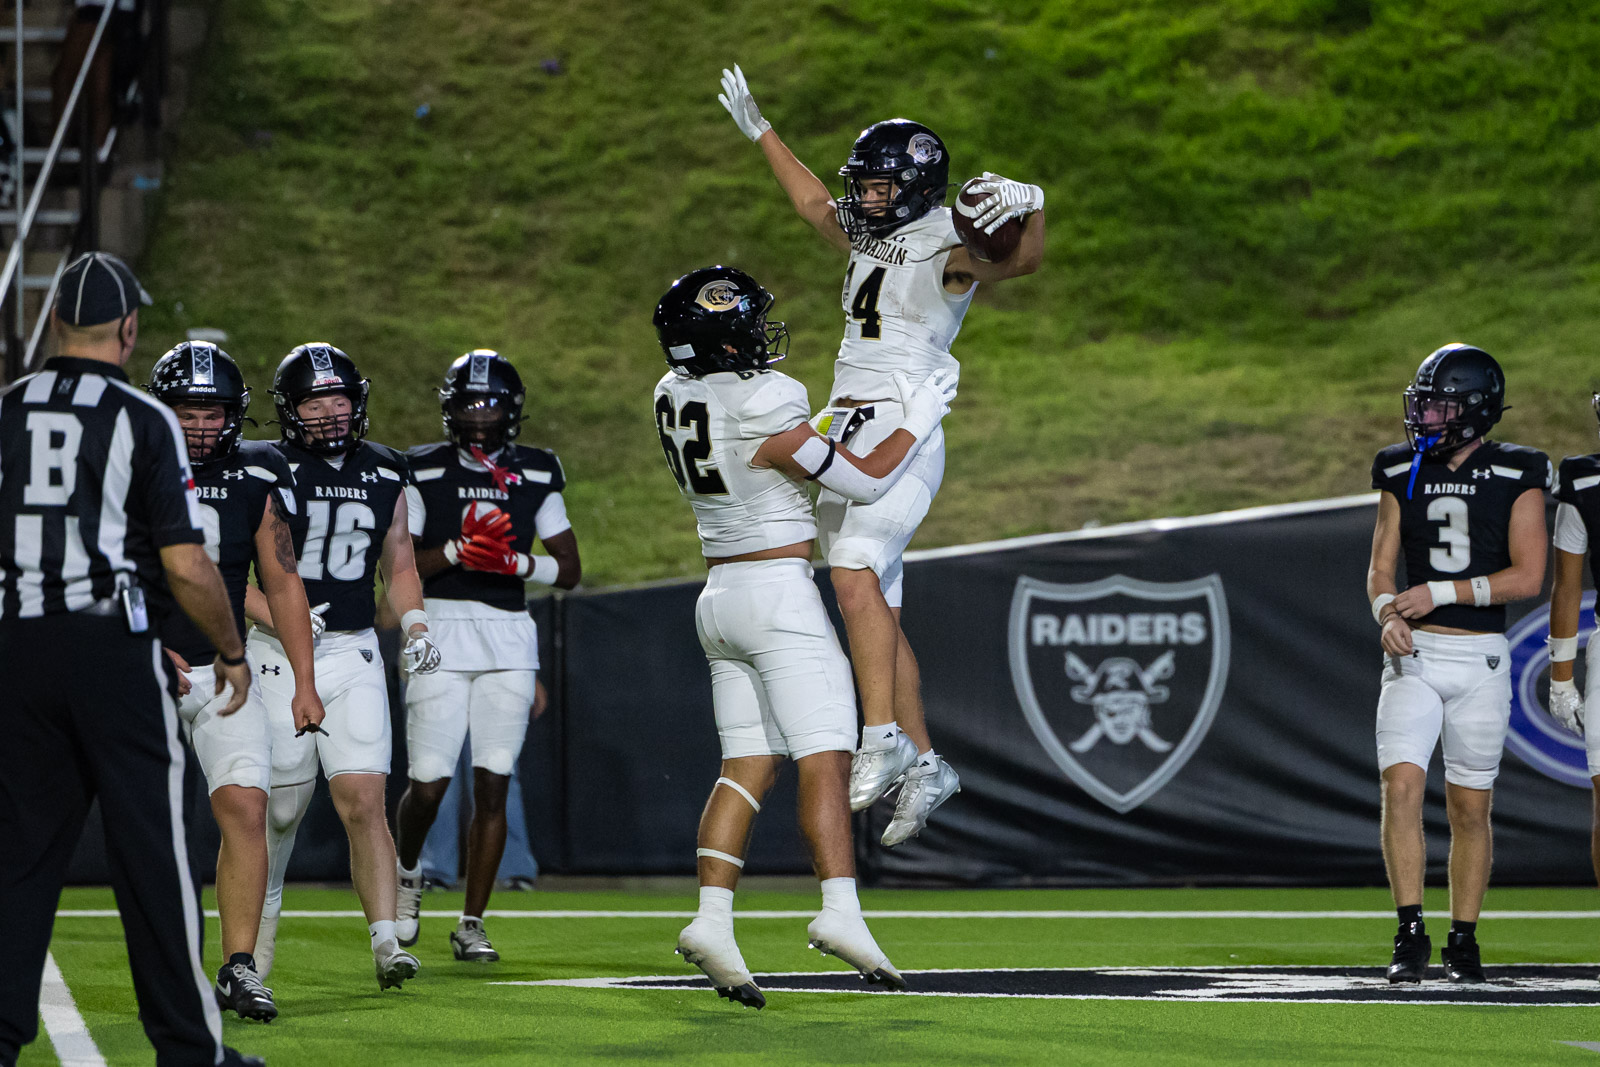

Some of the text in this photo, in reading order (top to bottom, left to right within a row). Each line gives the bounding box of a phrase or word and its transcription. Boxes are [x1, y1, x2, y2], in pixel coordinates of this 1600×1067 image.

[852, 235, 908, 266] ANADIAN
[23, 410, 84, 506] B
[655, 393, 731, 496] 62
[315, 486, 368, 501] RAIDERS
[1424, 483, 1477, 495] RAIDERS
[296, 500, 376, 581] 16
[1426, 495, 1471, 574] 3
[1031, 611, 1207, 646] RAIDERS
